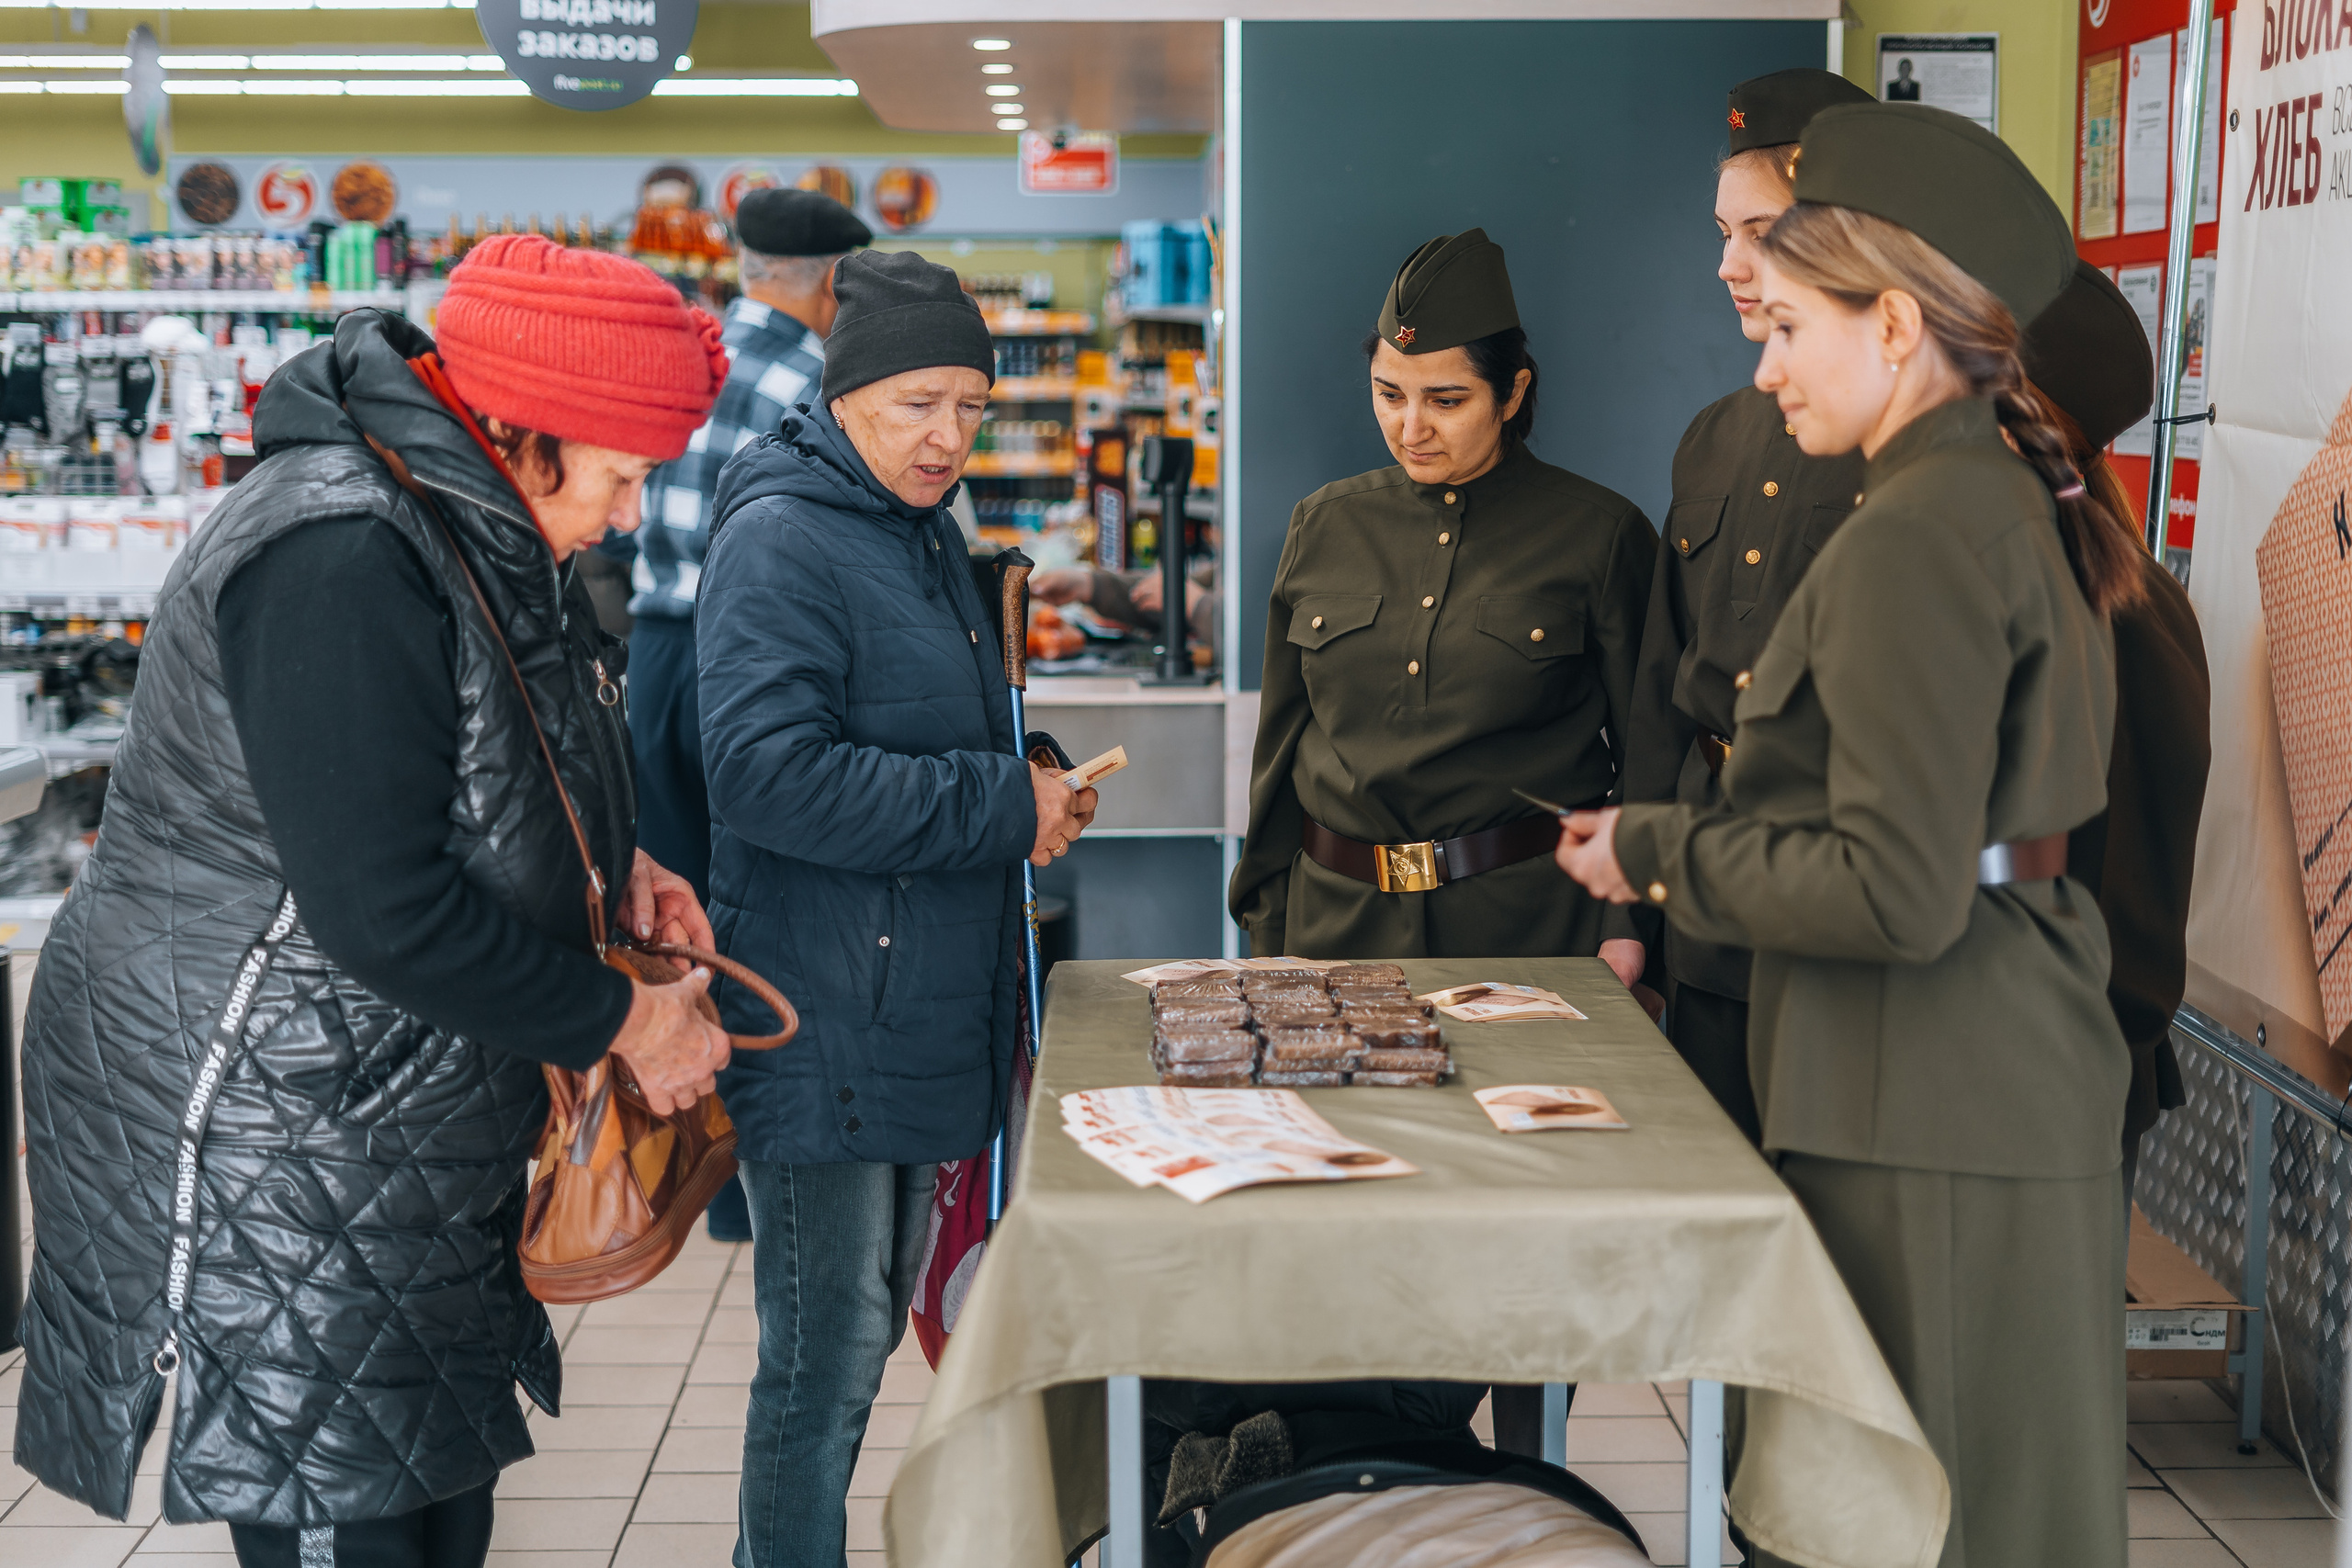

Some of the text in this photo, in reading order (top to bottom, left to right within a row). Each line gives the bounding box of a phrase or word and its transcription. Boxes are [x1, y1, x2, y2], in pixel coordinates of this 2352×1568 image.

[517, 29, 660, 62] заказов
[2244, 92, 2324, 212] ХЛЕБ
[2332, 84, 2352, 136] ВС
[220, 949, 268, 1034] FASHION
[184, 1043, 227, 1132] FASHION
[175, 1139, 197, 1222] FASHION
